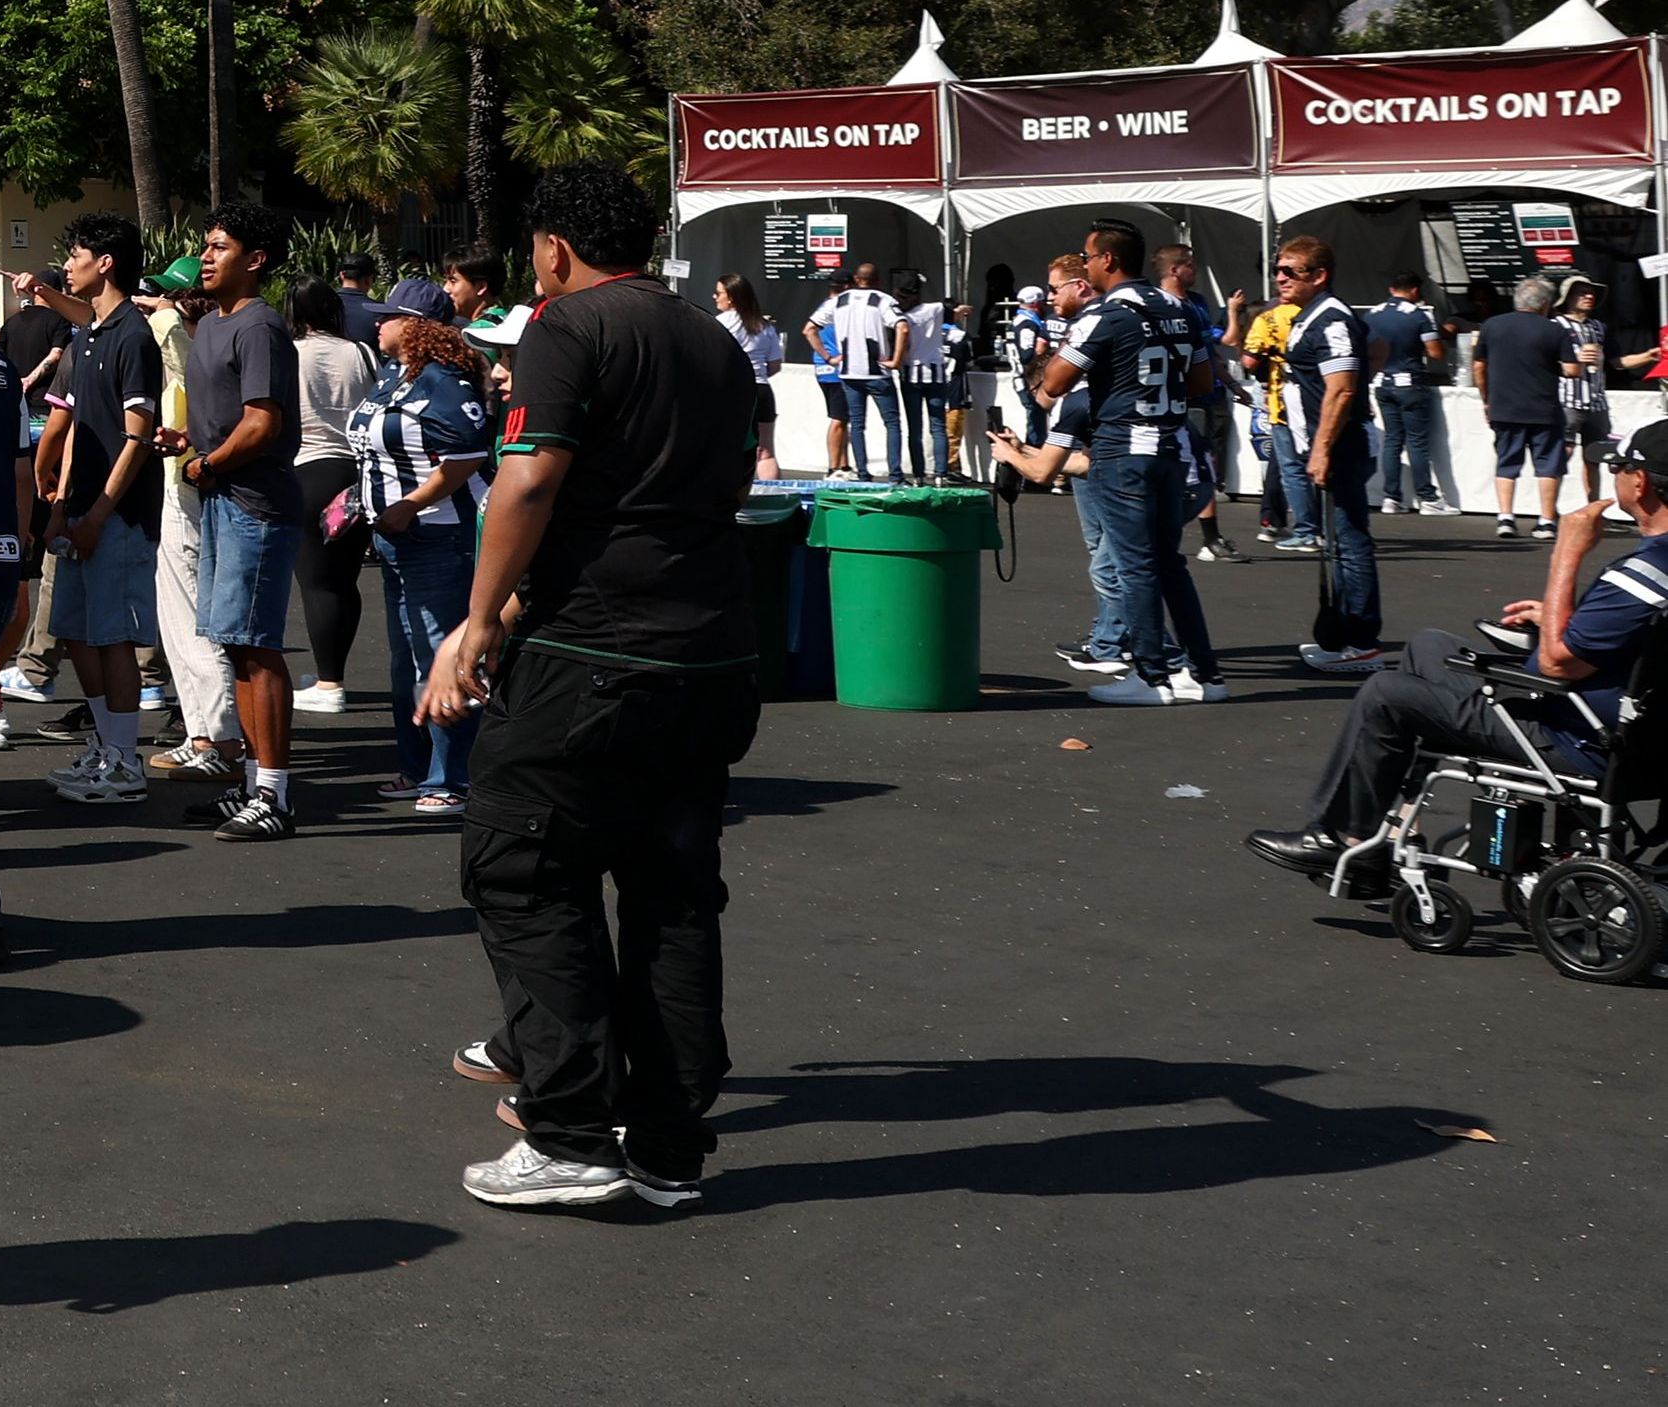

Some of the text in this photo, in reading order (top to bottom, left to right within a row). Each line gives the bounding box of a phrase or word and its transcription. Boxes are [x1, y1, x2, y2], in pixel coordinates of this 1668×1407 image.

[1305, 87, 1622, 126] COCKTAILS ON TAP
[703, 122, 920, 151] COCKTAILS ON TAP
[1022, 109, 1189, 142] BEER WINE
[1135, 344, 1194, 417] 93
